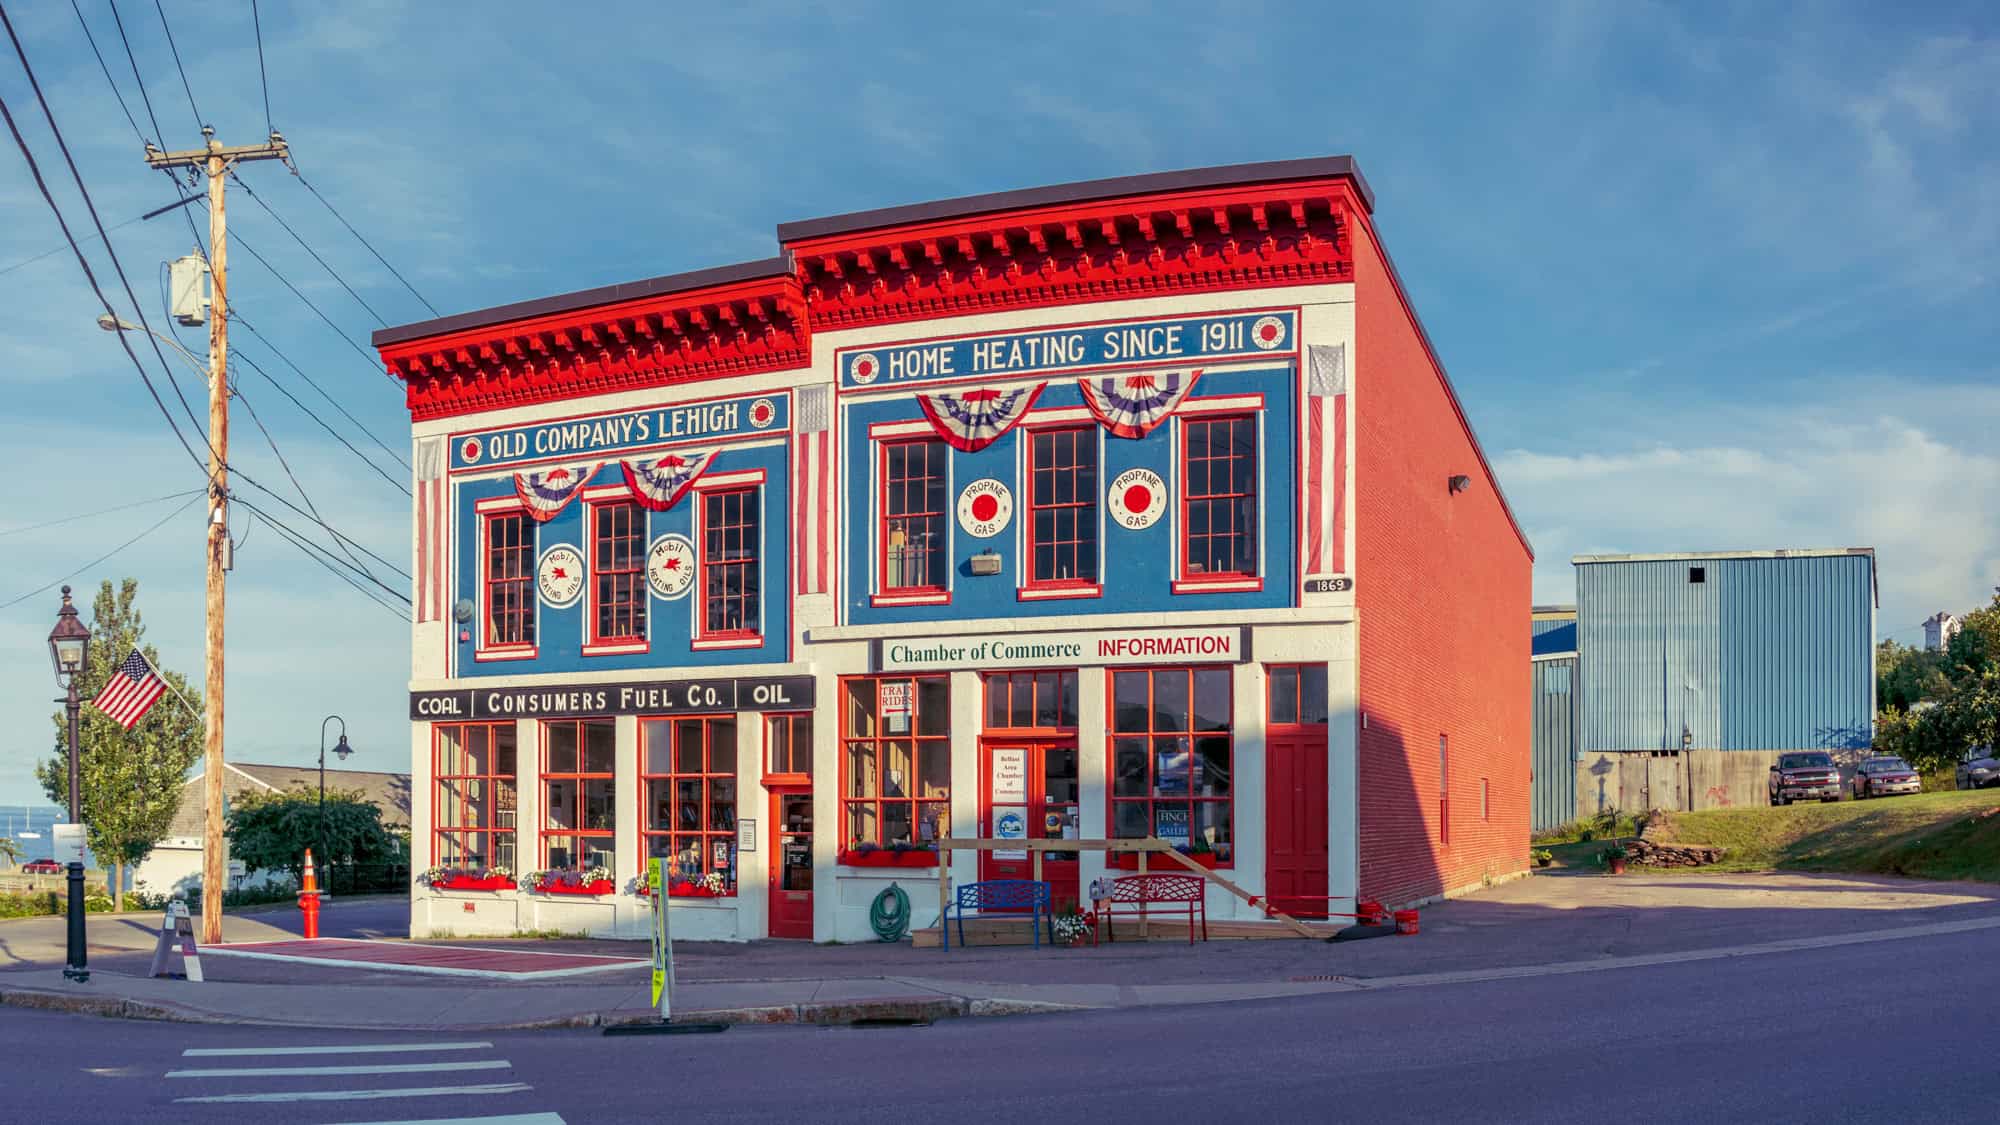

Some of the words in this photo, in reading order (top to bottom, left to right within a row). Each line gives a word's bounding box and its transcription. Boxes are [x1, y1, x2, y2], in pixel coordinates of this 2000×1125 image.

[889, 346, 955, 380] HOME
[972, 334, 1086, 372] HEATING
[1103, 325, 1184, 360] SINCE
[1201, 320, 1244, 351] 1911
[489, 432, 527, 459] OLD
[535, 413, 650, 453] COMPANY'S
[658, 402, 739, 438] LEHIGH
[965, 481, 1007, 499] PROPANE
[1116, 470, 1160, 490] PROPANE
[974, 523, 996, 535] GAS
[1126, 515, 1148, 527] GAS
[549, 552, 575, 564] Mobil
[655, 542, 684, 556] Mobil
[540, 574, 562, 600] HEATING
[567, 576, 581, 596] OILS
[650, 567, 674, 593] HEATING
[680, 565, 693, 586] OILS
[1317, 579, 1344, 592] 1869
[891, 643, 966, 663] Chamber
[971, 642, 988, 660] of
[991, 641, 1081, 660] Commerce
[1098, 636, 1230, 657] INFORMATION
[488, 691, 607, 713] CONSUMERS
[620, 687, 673, 709] FUEL
[687, 684, 723, 707] CO.
[753, 684, 791, 704] OIL
[418, 697, 462, 715] COAL
